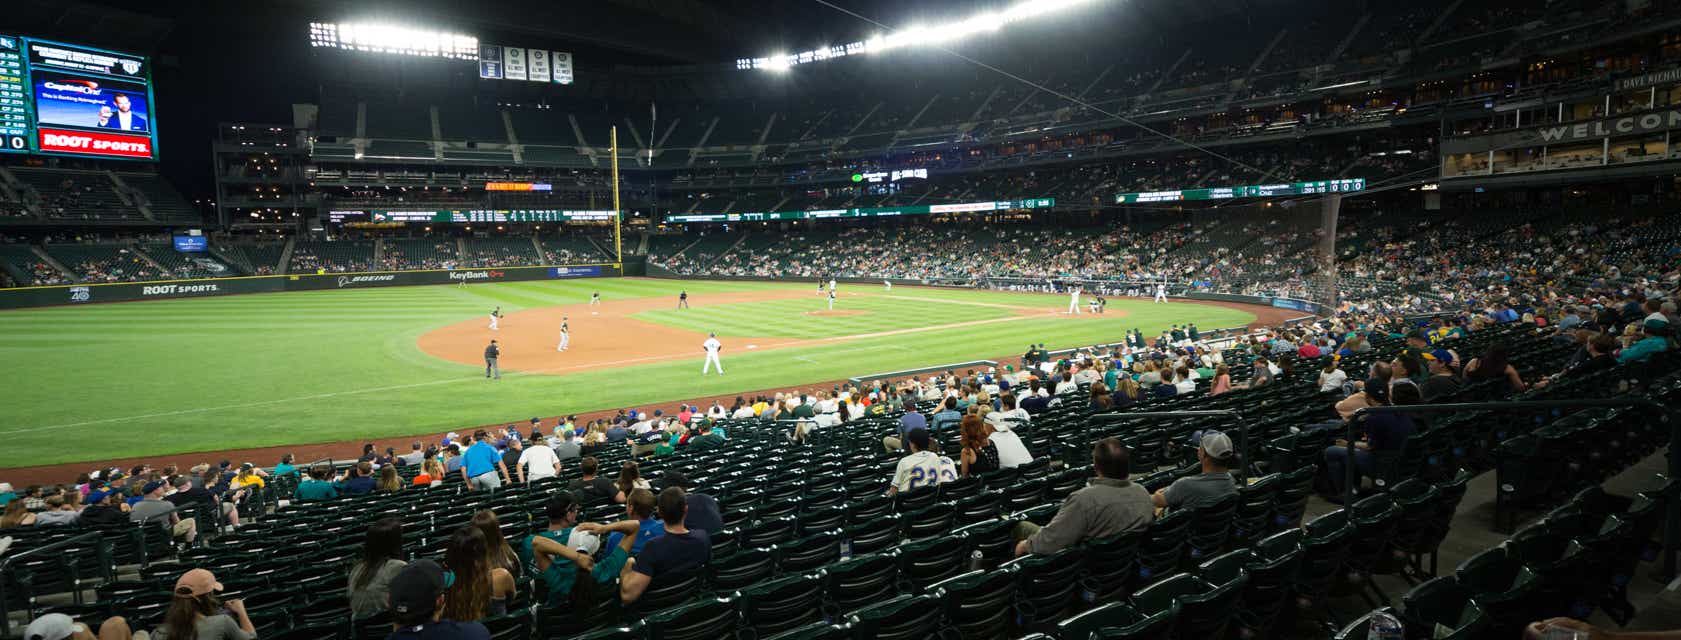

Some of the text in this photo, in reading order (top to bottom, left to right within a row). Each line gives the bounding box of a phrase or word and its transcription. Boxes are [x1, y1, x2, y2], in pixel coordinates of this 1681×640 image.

[44, 134, 92, 148] ROOT
[450, 271, 488, 280] KeyBank
[143, 285, 176, 295] ROOT
